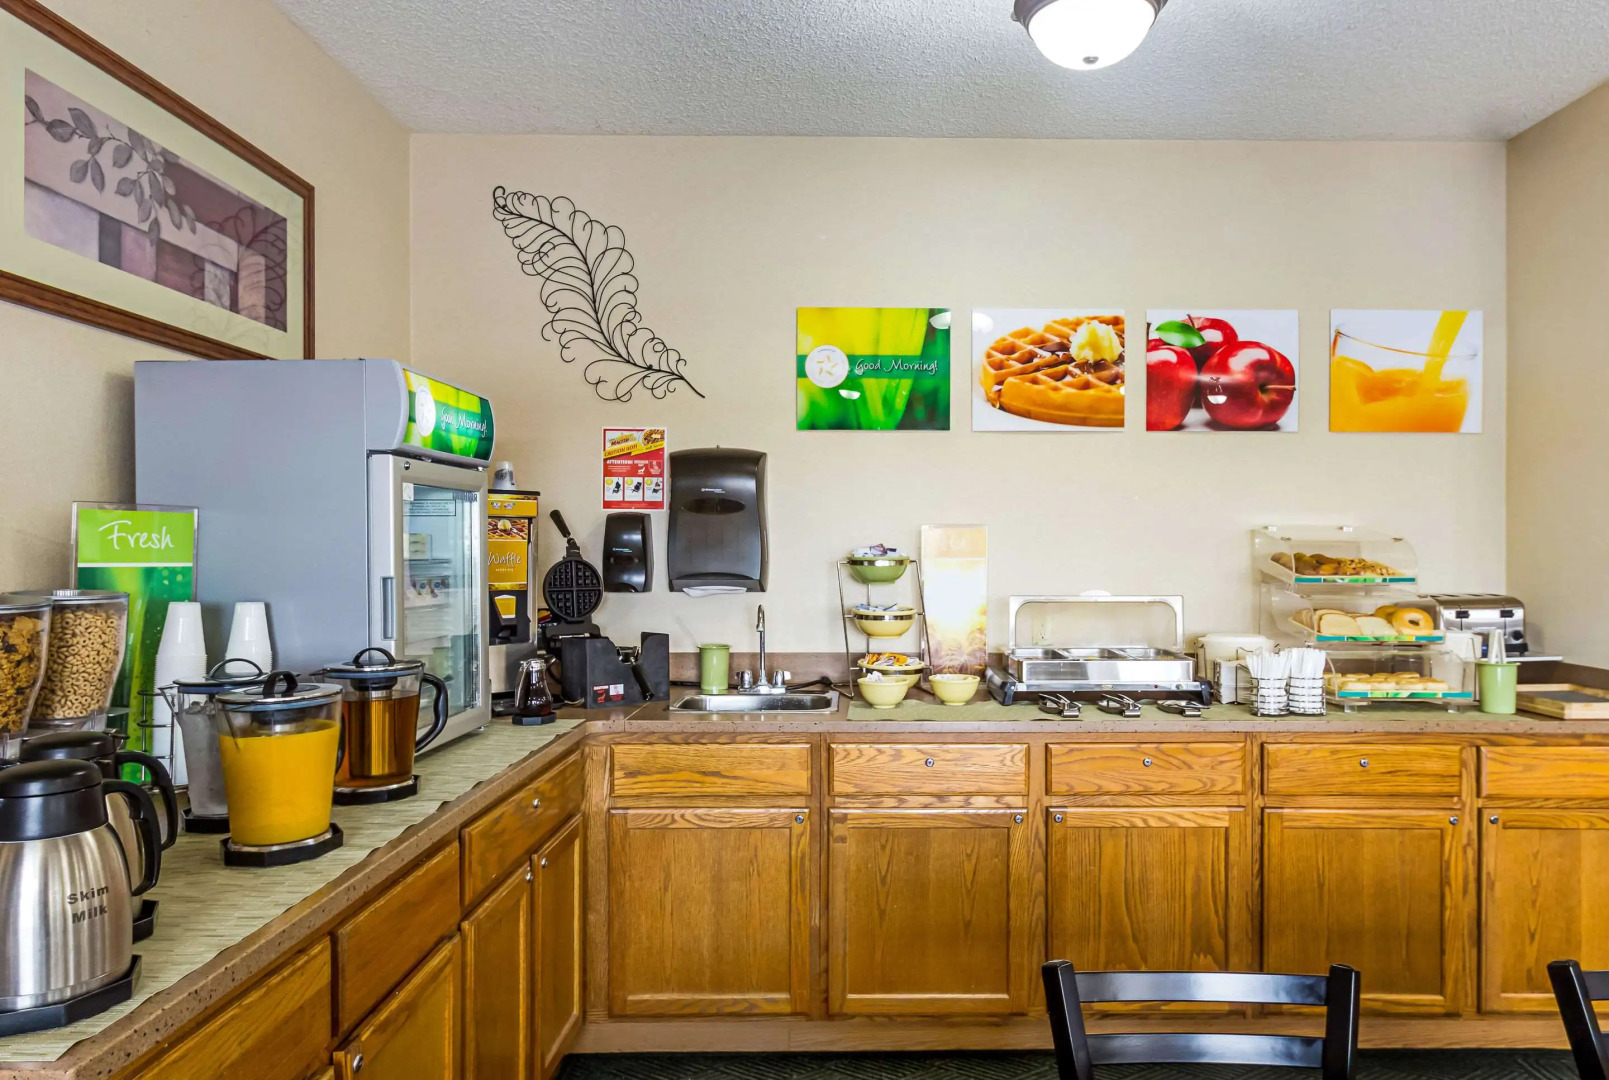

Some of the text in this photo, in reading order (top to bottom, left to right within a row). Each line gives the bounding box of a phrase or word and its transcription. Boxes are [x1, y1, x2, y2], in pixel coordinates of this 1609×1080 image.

[855, 359, 938, 375] Good Morning!
[455, 413, 488, 438] Morning!
[98, 520, 175, 550] Fresh
[487, 552, 522, 568] Waffle
[67, 886, 109, 905] Skim
[72, 905, 108, 924] Milk
